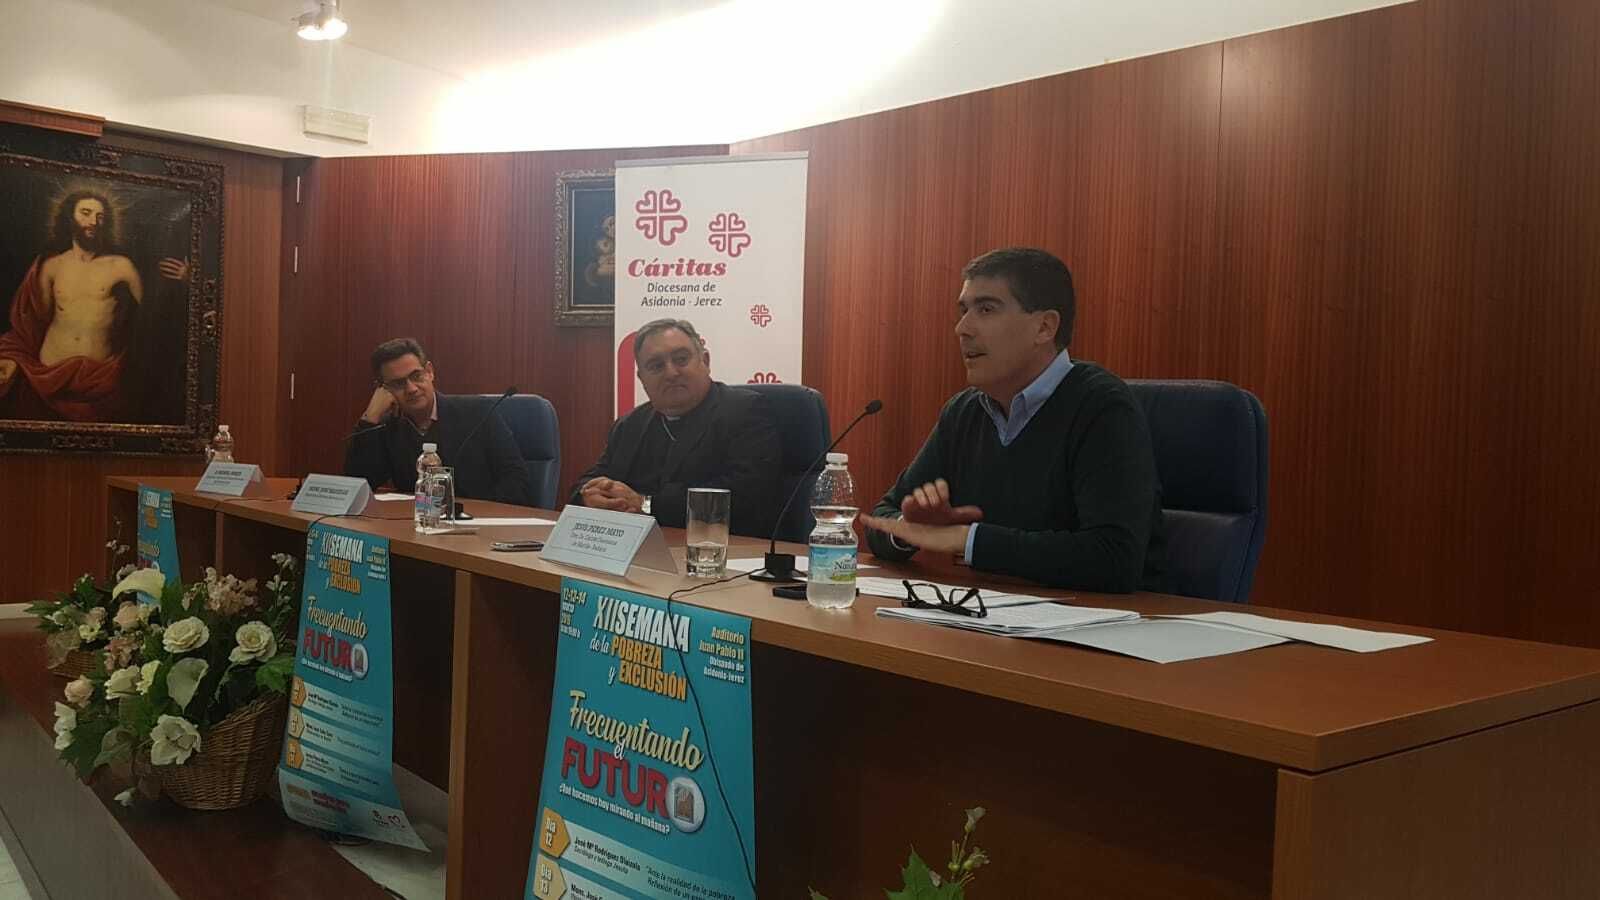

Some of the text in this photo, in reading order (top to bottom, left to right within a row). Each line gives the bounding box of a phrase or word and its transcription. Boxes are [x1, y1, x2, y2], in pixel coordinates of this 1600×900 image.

[628, 257, 726, 277] Cáritas
[647, 281, 716, 293] Diocesana de
[641, 296, 686, 307] Asidonia
[694, 296, 722, 307] Jerez
[711, 626, 744, 645] Auditorio
[611, 635, 662, 670] POBREZA
[699, 640, 716, 654] Juan
[716, 644, 737, 658] Pablo
[608, 660, 687, 701] y EXCLUSIÓN
[569, 689, 704, 771] Frecuentando
[614, 737, 626, 760] el
[598, 796, 609, 812] hoy
[545, 832, 553, 848] 12
